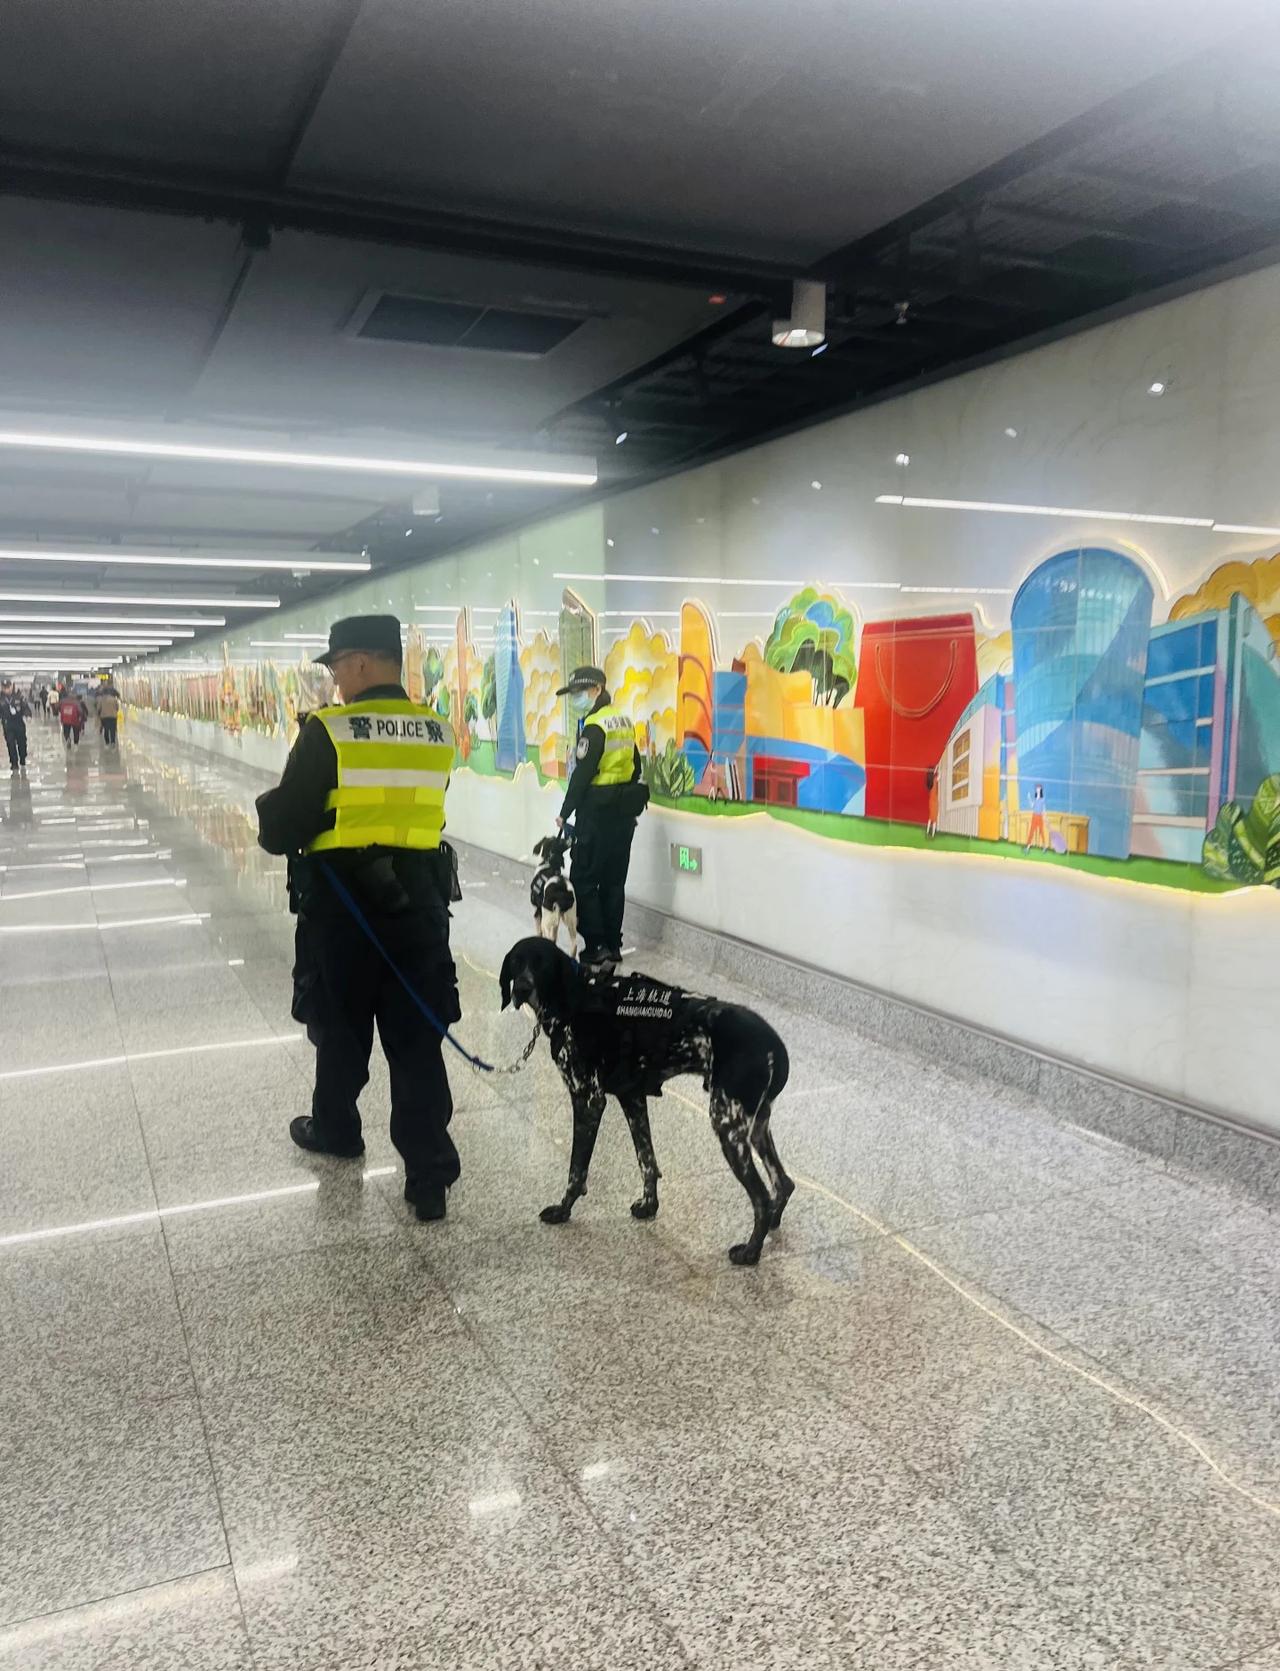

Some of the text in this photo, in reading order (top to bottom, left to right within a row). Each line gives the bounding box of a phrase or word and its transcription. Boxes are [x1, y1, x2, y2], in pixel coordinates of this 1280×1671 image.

[348, 716, 445, 743] 警 POLICE 察
